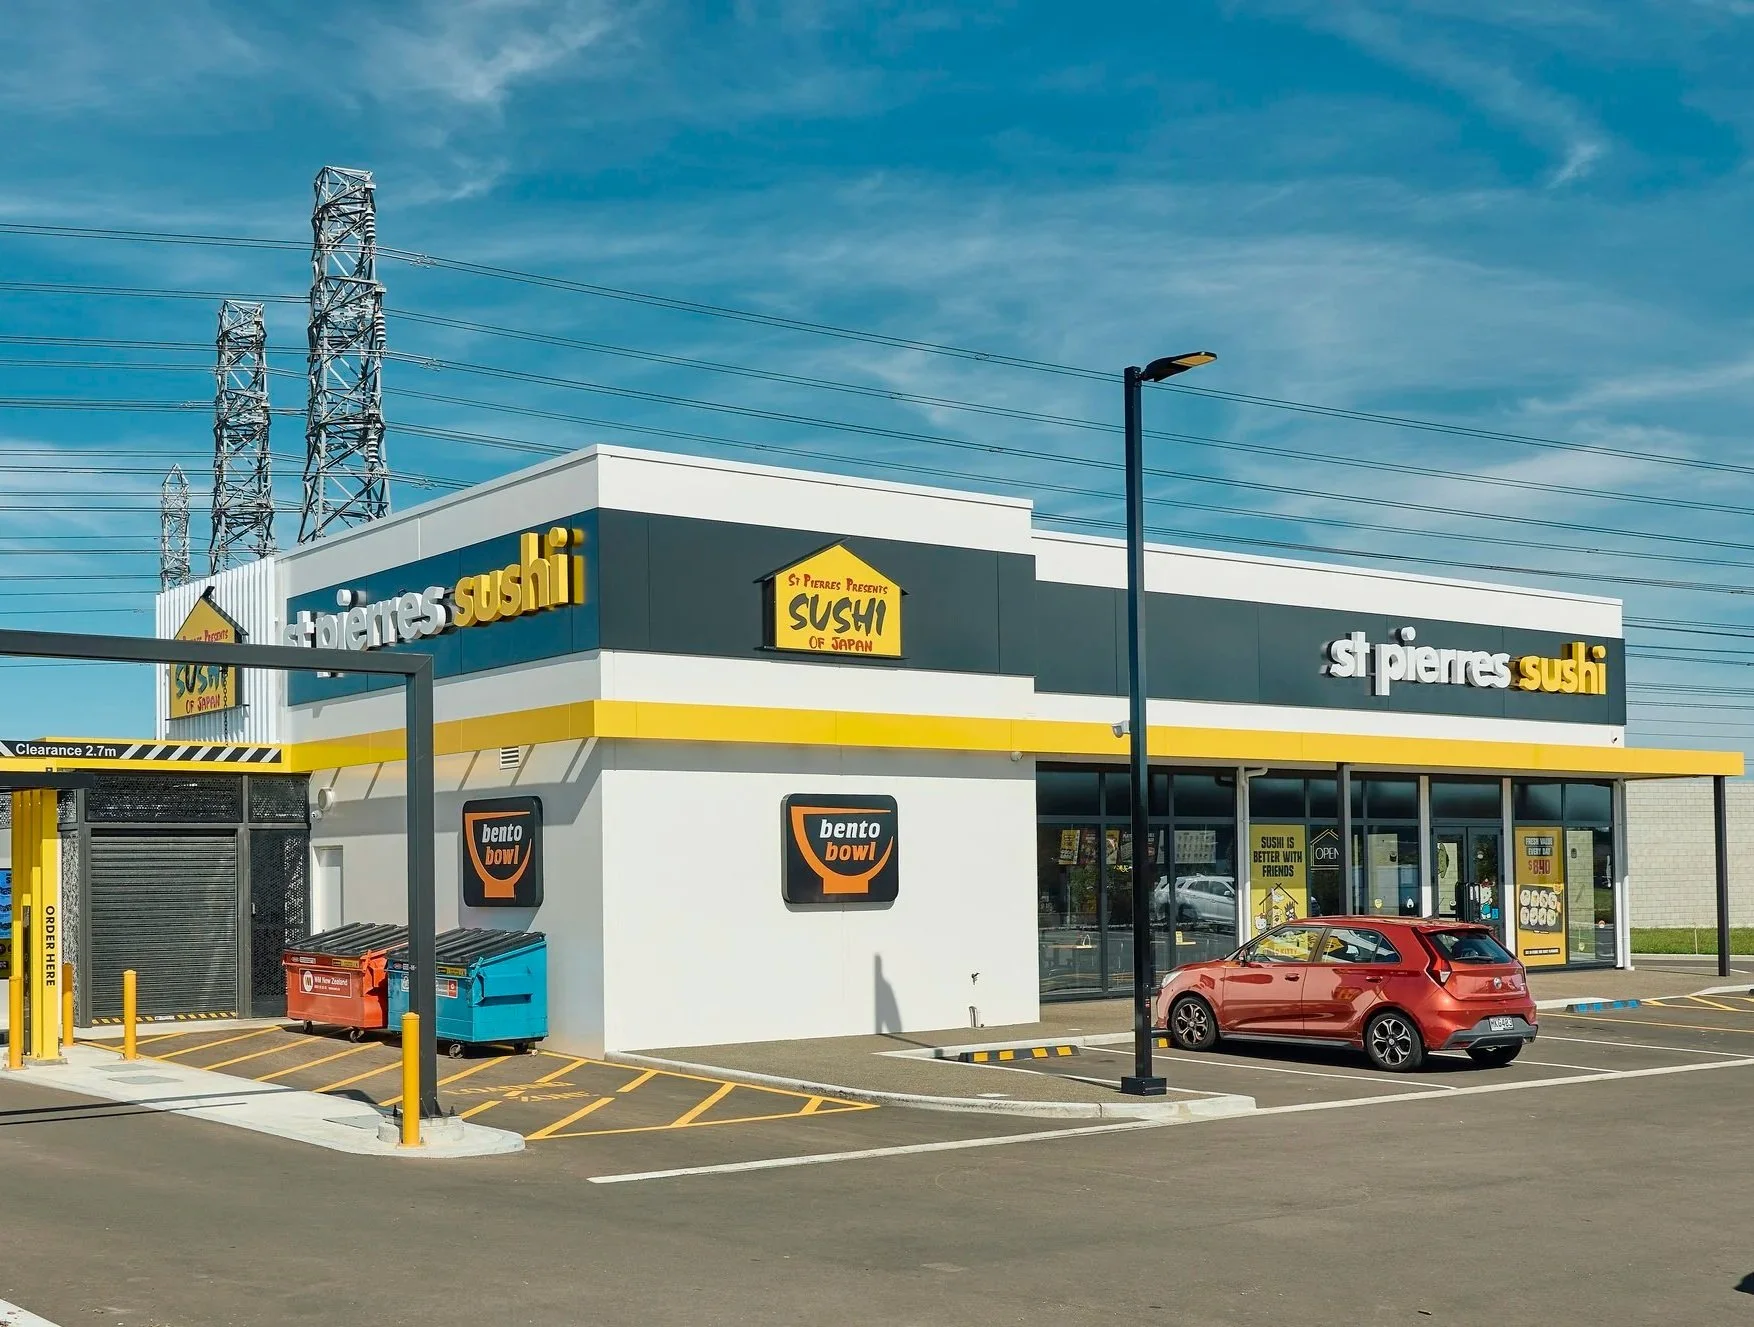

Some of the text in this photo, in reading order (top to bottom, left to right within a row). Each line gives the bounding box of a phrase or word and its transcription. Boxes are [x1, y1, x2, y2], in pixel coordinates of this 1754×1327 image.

[803, 573, 841, 590] PIERRES
[846, 577, 888, 594] PRESENTS
[283, 527, 569, 677] st pierres sushi
[788, 592, 887, 636] SUSHI
[808, 635, 873, 652] OF JAPAN
[1329, 626, 1606, 696] st pierres sushi
[185, 693, 221, 714] OF JAPAN
[15, 743, 117, 757] Clearance 2.7m
[482, 823, 523, 843] bento
[819, 818, 881, 839] bento
[825, 841, 877, 861] bowl
[1260, 836, 1295, 849] SUSHI IS
[1528, 847, 1541, 856] EVERY
[485, 844, 520, 865] bowl
[1253, 850, 1302, 863] BETTER WITH
[1262, 864, 1294, 877] FRIENDS
[45, 905, 56, 987] ORDER HERE
[322, 976, 331, 984] New
[331, 977, 348, 986] Zealand
